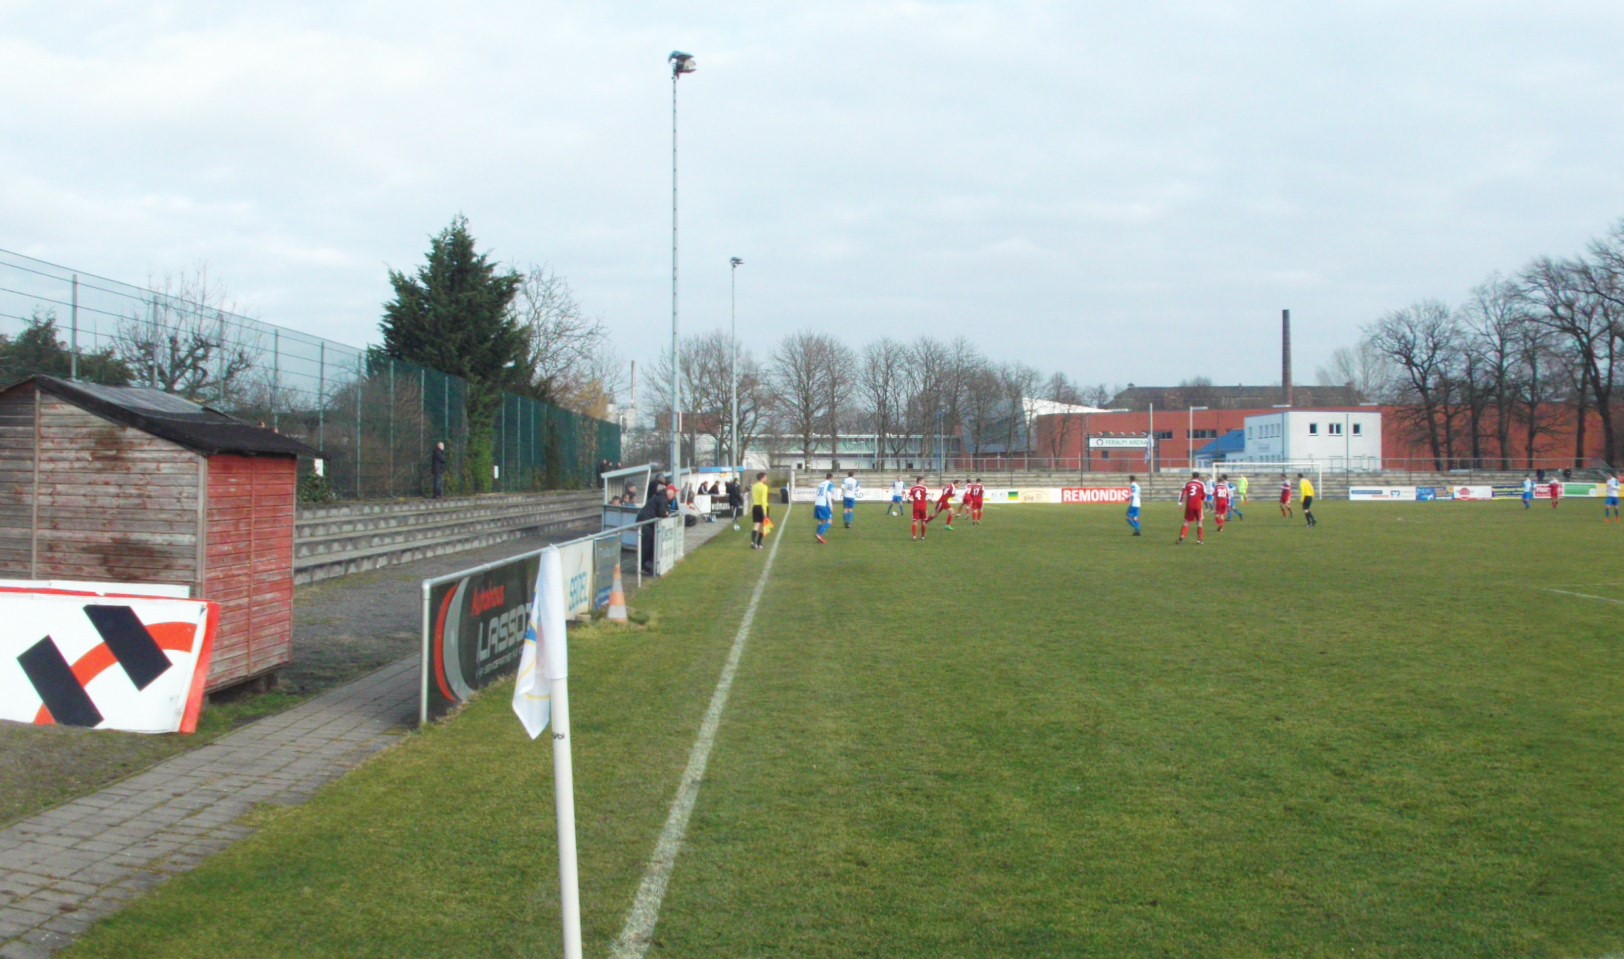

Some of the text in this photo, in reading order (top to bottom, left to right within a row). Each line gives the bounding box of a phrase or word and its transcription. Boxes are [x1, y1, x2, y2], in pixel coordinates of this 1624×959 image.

[915, 489, 922, 501] 4
[1063, 489, 1128, 502] REMONDIS
[1189, 485, 1197, 496] 3
[1217, 488, 1227, 498] 20
